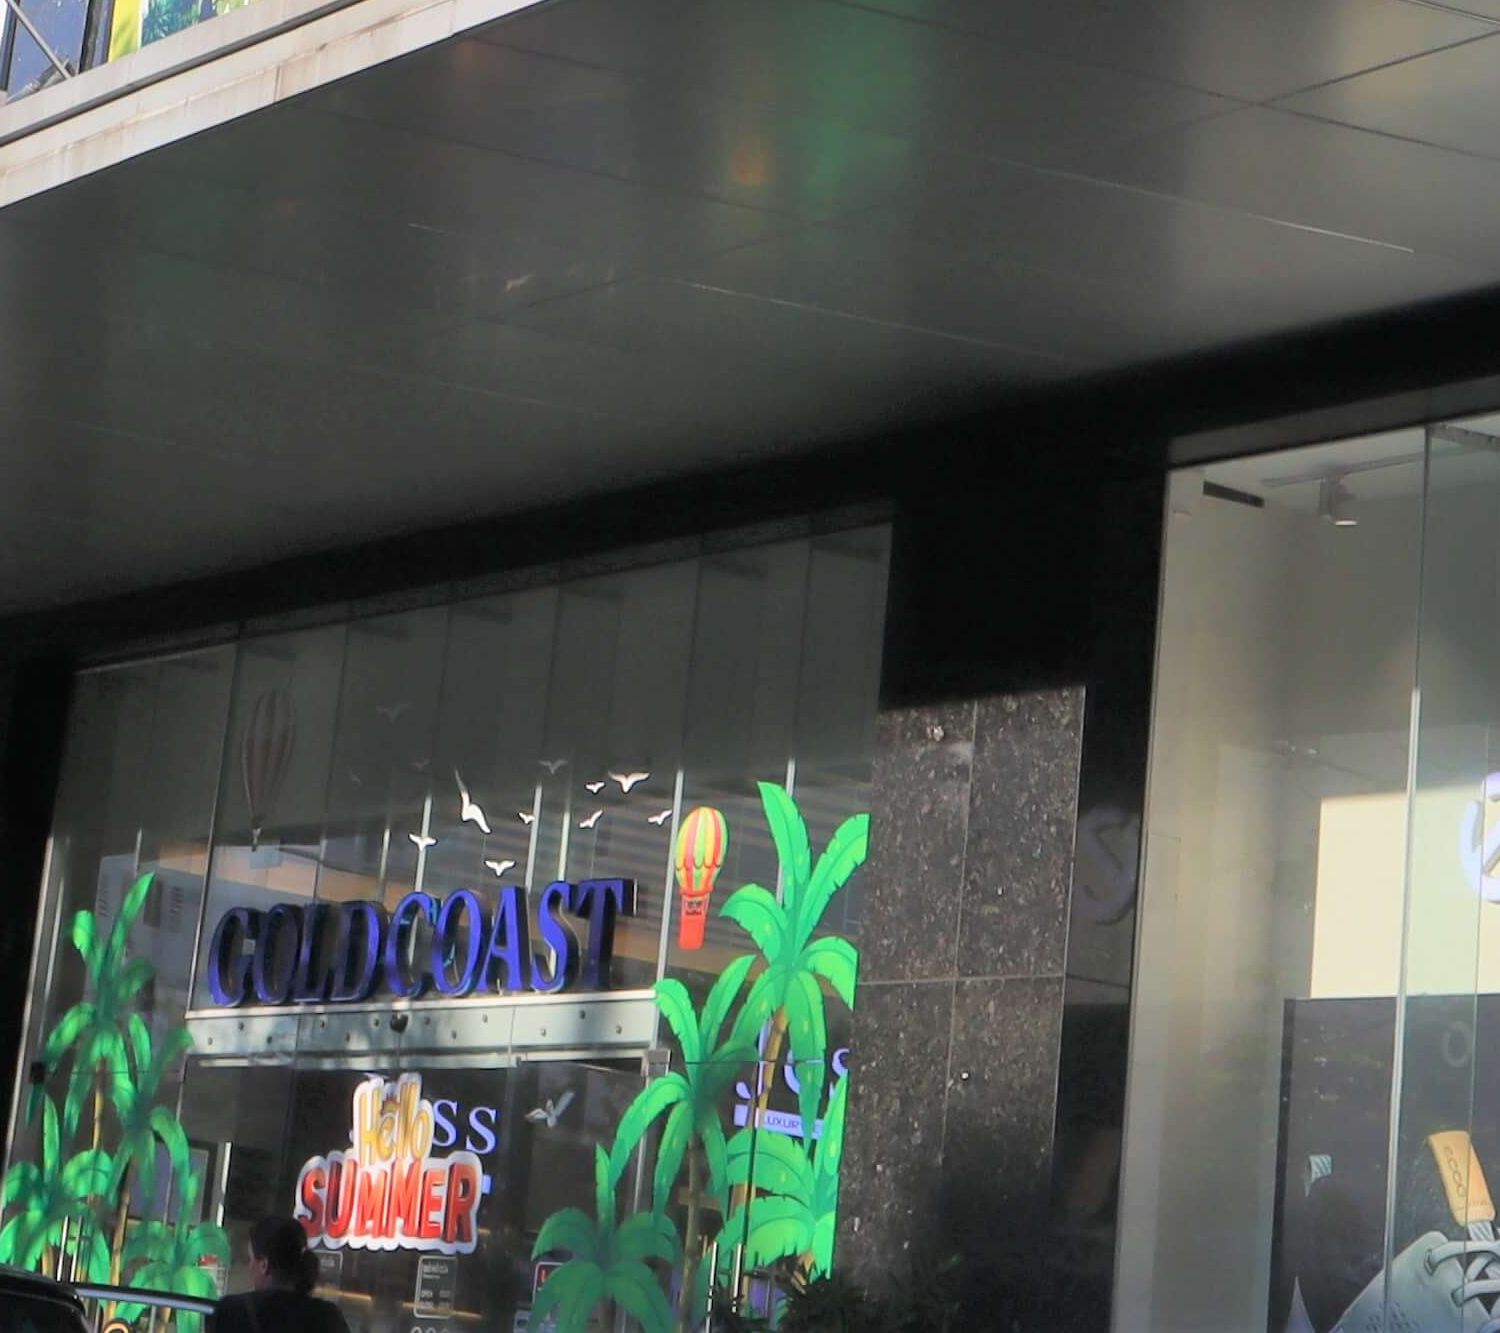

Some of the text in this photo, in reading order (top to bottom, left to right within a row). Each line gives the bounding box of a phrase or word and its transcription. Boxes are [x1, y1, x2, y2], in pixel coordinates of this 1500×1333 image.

[207, 877, 636, 1008] GOLDCOAST
[359, 1081, 429, 1168] Hello
[298, 1158, 478, 1244] SUMMER
